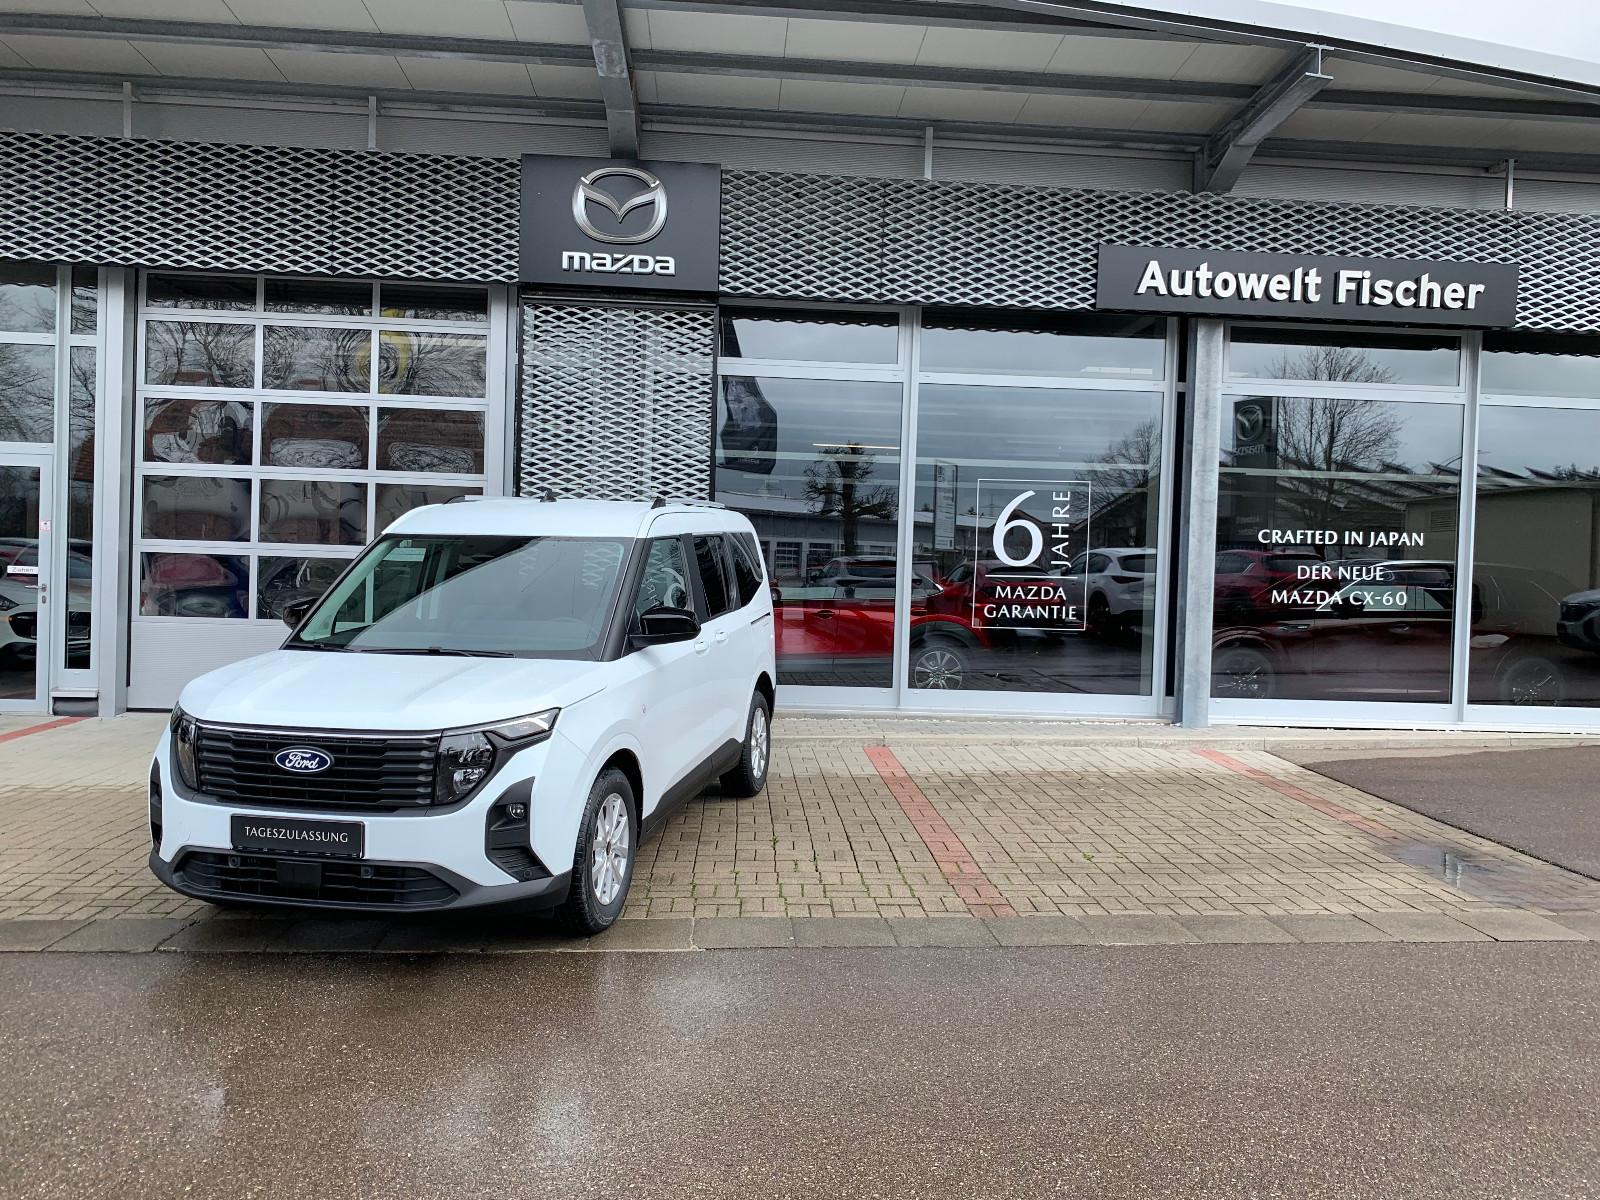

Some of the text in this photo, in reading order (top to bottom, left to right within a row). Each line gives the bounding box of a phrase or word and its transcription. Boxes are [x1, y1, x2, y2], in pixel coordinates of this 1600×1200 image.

[562, 251, 676, 276] mazda
[1136, 260, 1485, 309] Autowelt Fischer
[992, 490, 1043, 567] 6
[1051, 491, 1071, 568] JAHRE
[1257, 529, 1424, 548] CRAFTED IN JAPAN
[1297, 565, 1385, 581] DER NEUE
[995, 586, 1067, 600] MAZDA
[1271, 590, 1408, 606] MAZDA CX-60
[983, 604, 1077, 620] GARANTIE
[285, 751, 320, 769] Ford
[244, 826, 348, 843] TAGESZULASSUNG
